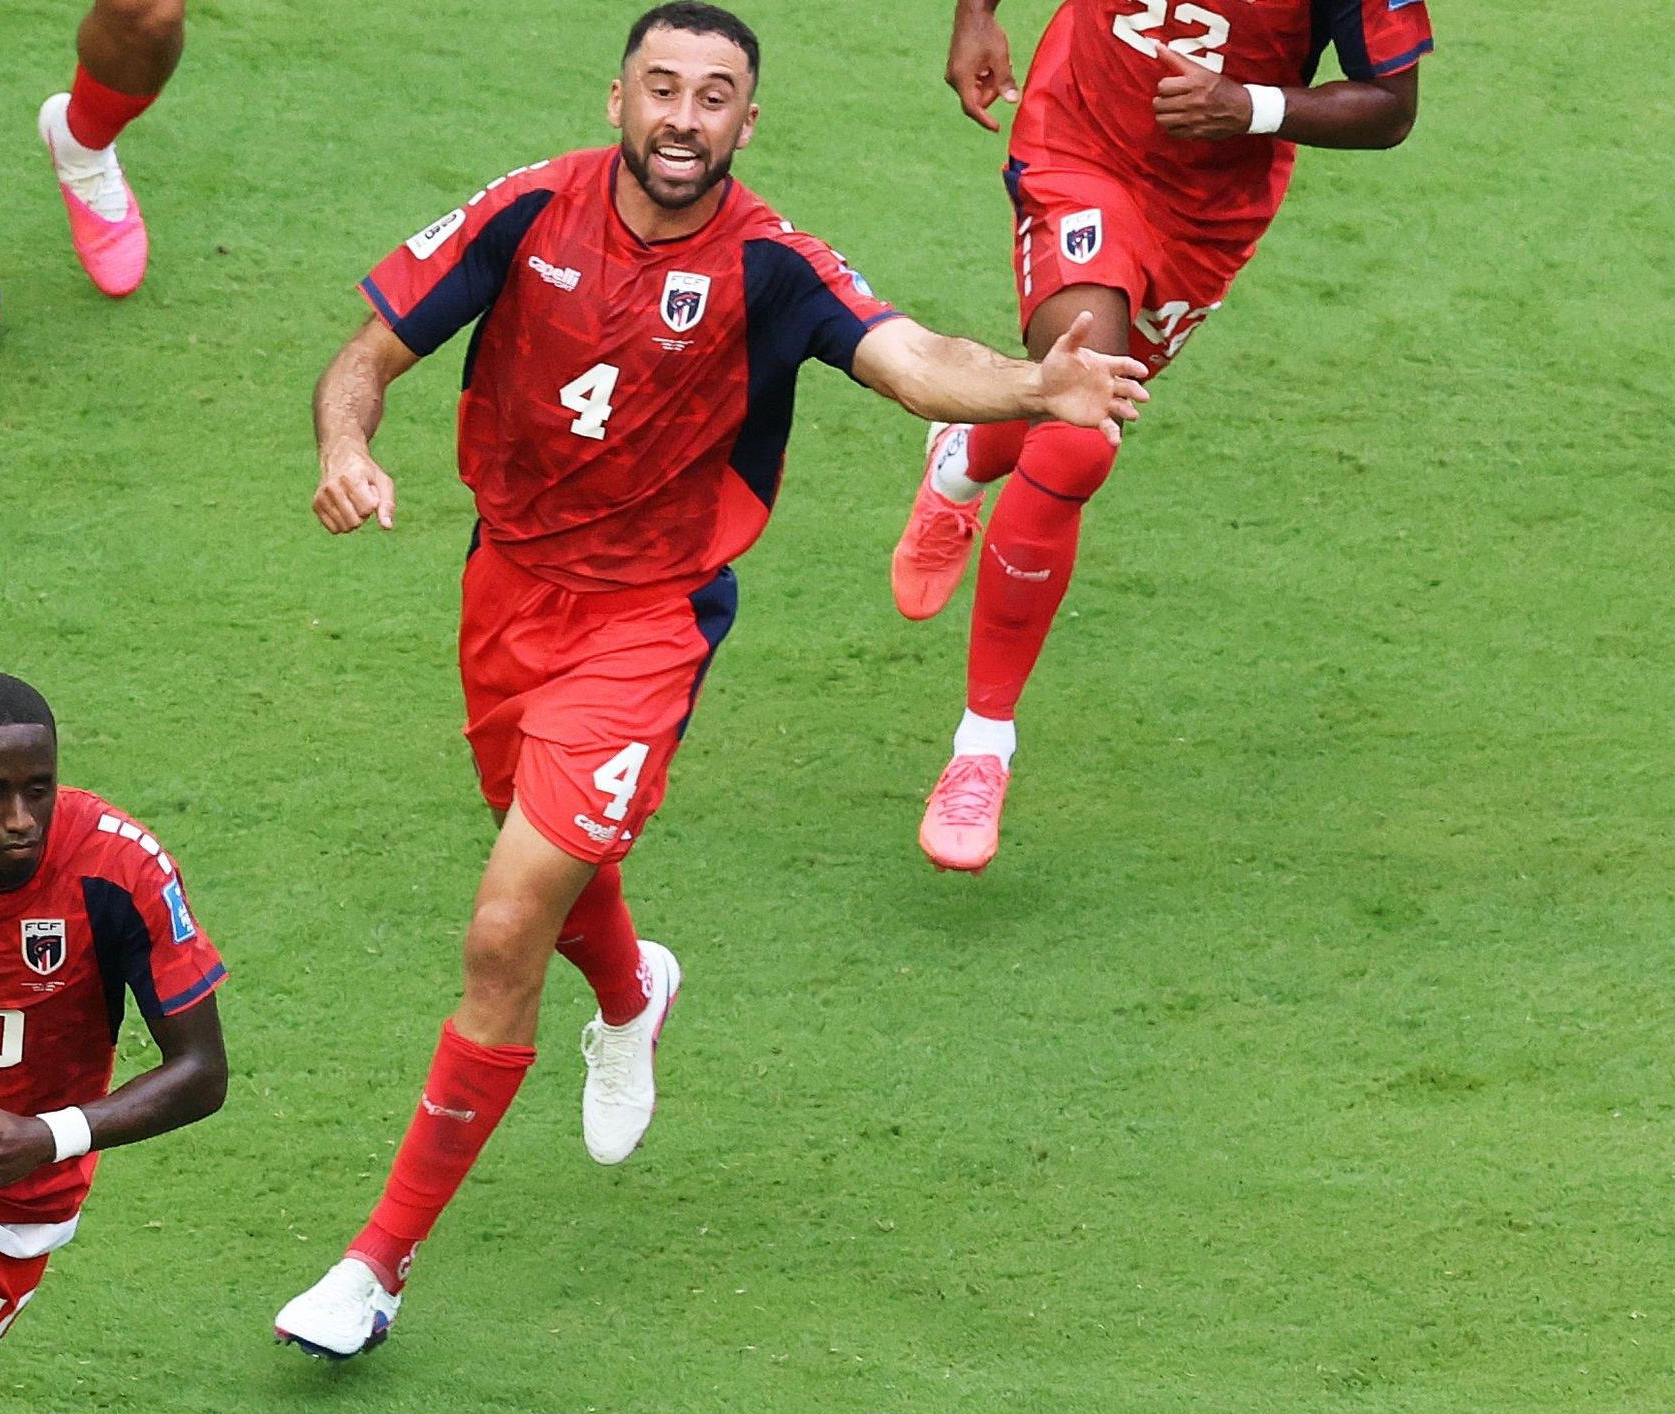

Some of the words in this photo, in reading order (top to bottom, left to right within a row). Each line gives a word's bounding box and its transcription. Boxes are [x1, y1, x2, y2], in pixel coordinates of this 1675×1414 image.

[559, 362, 620, 441] 4
[592, 741, 650, 821] 4
[24, 922, 61, 931] FCF
